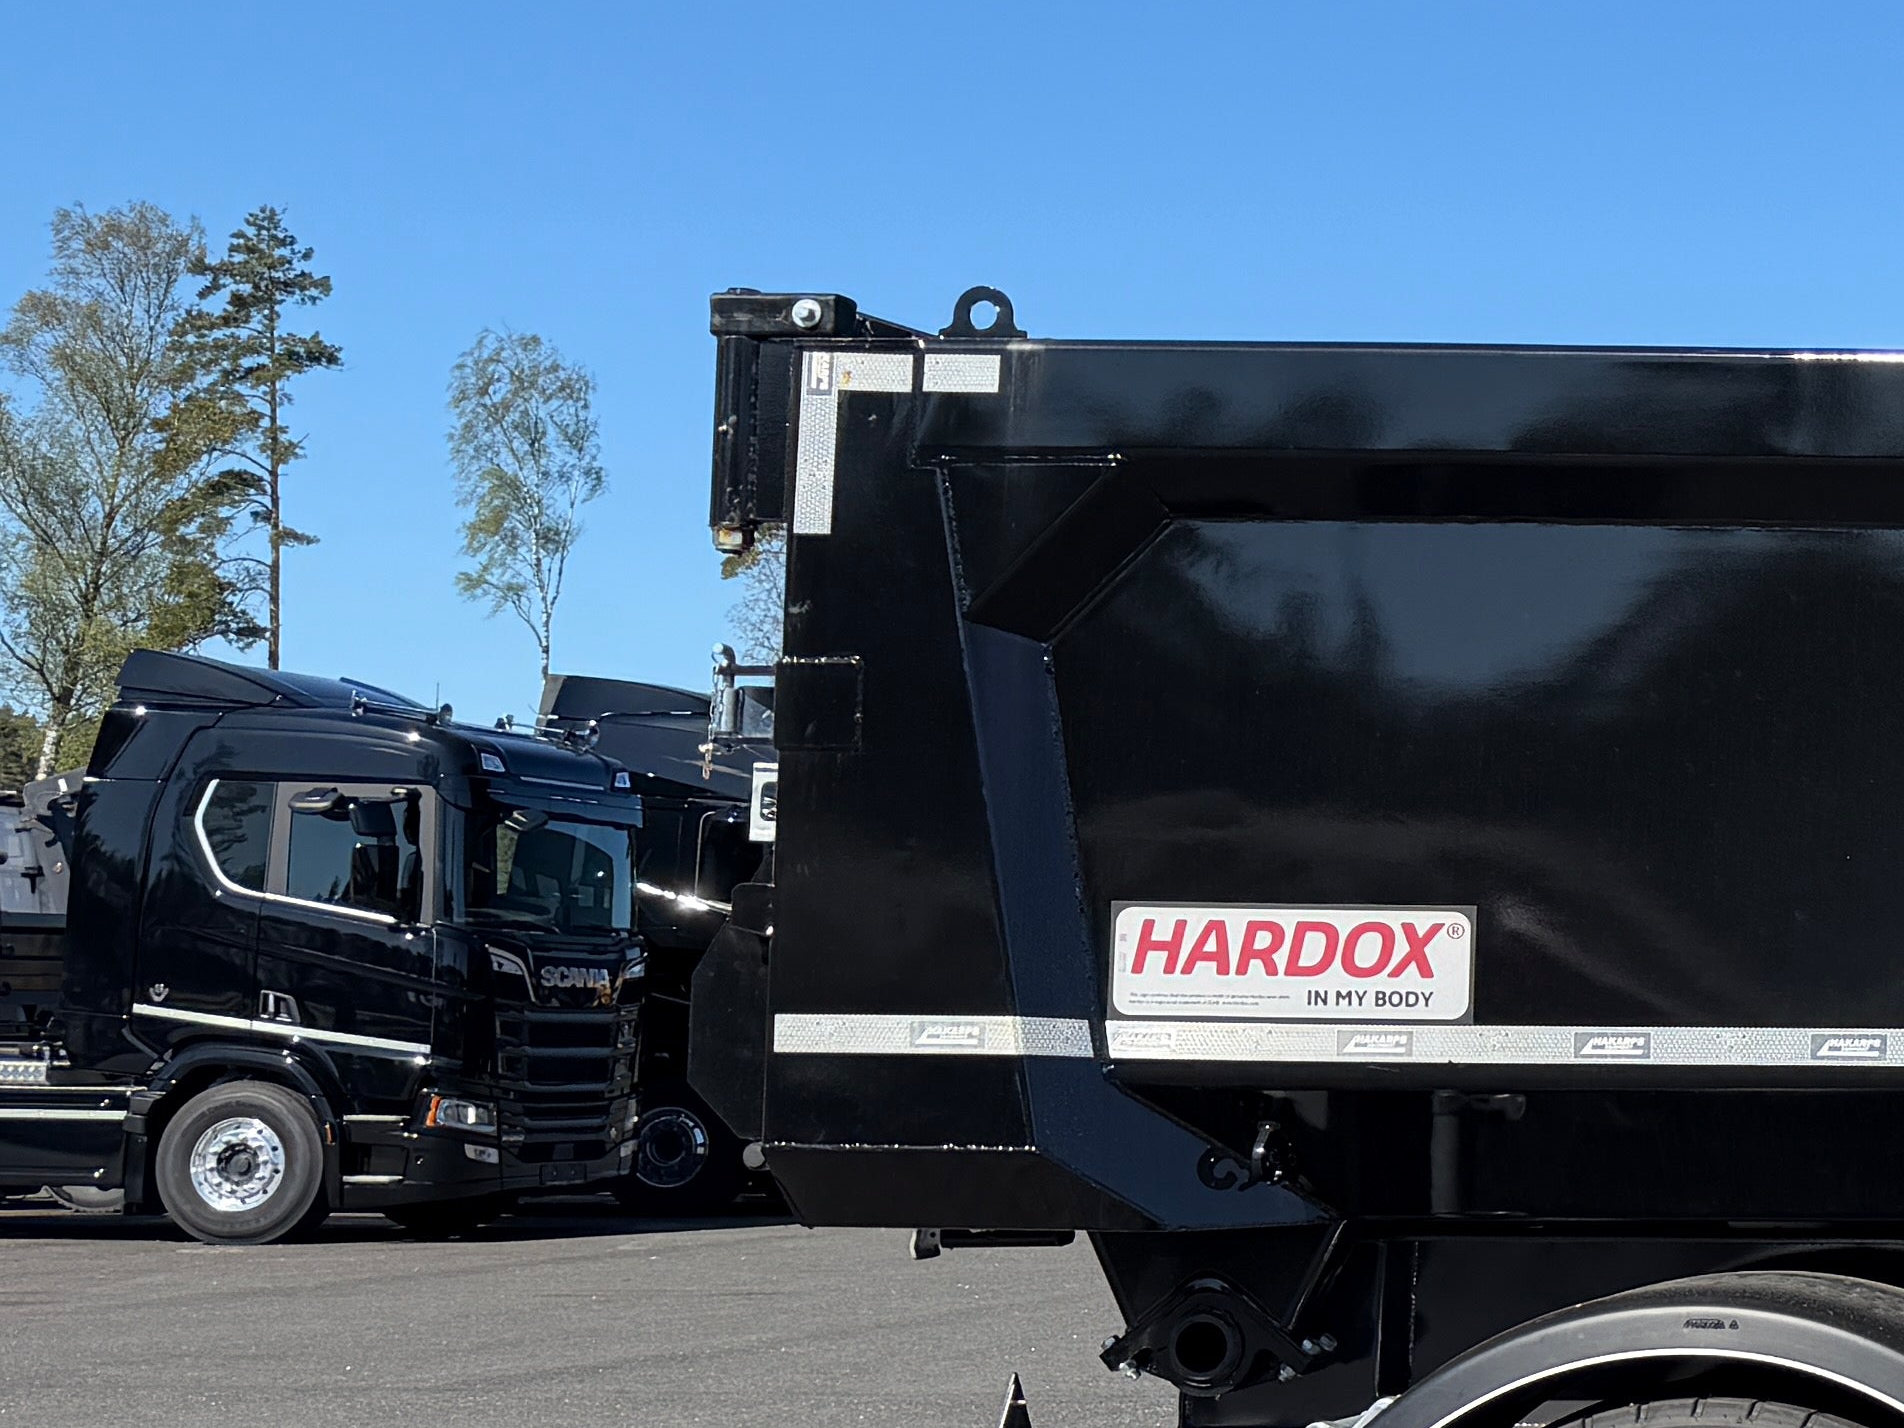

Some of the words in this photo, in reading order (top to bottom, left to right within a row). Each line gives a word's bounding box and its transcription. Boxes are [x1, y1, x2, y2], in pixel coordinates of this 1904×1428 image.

[540, 965, 610, 988] SCANIA
[1307, 990, 1328, 1006] IN
[1335, 990, 1367, 1007] MY
[1374, 990, 1434, 1008] BODY
